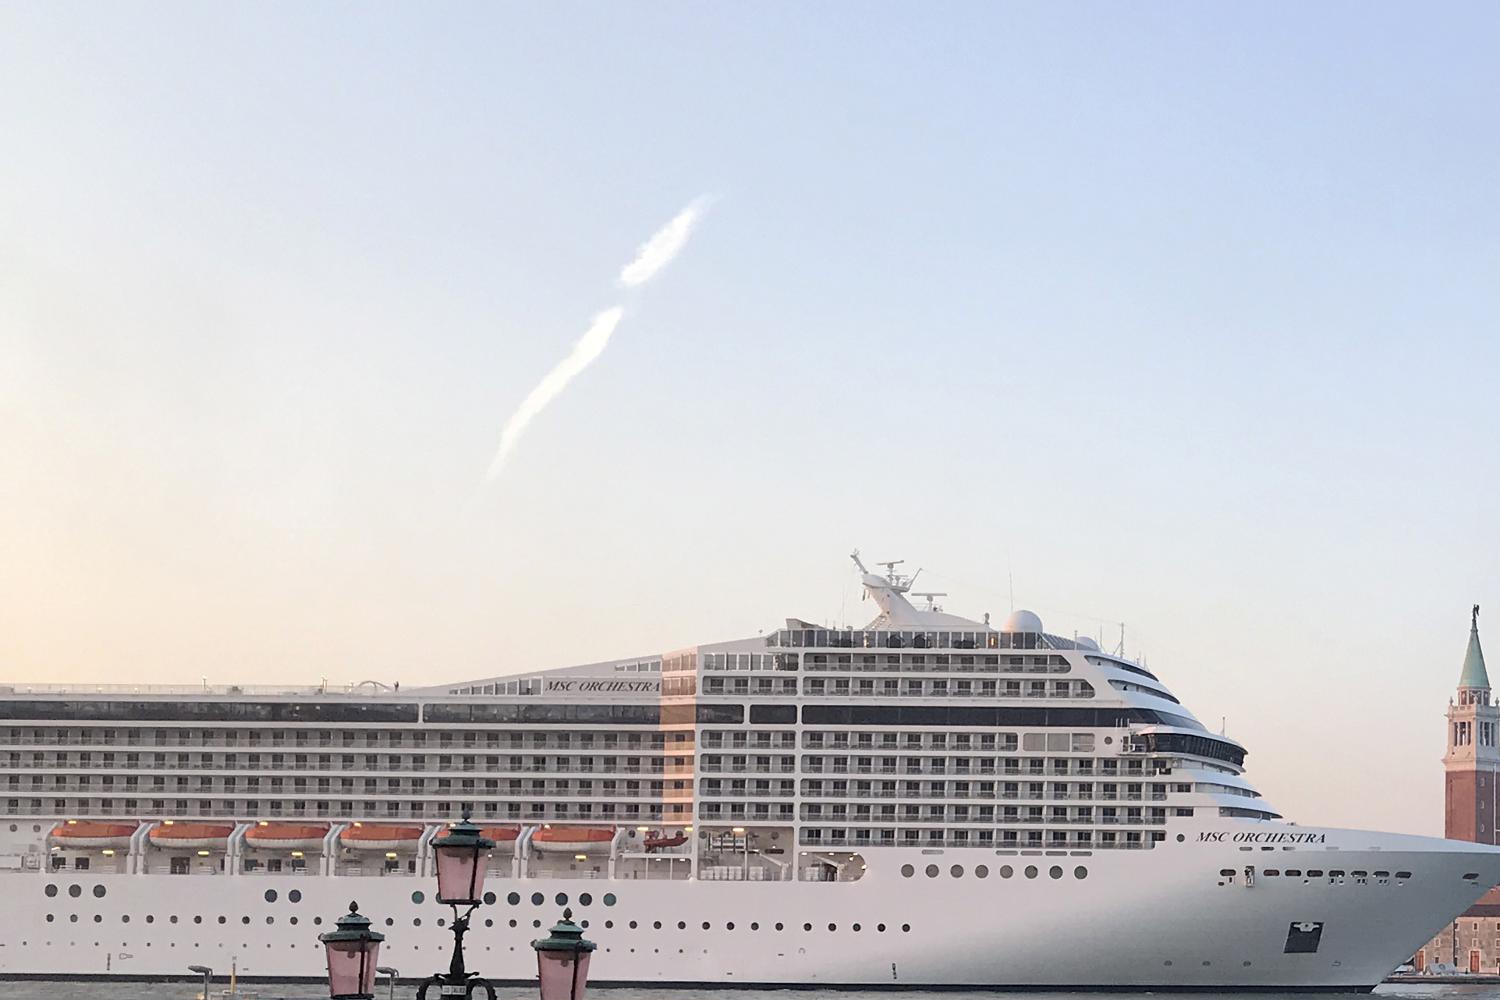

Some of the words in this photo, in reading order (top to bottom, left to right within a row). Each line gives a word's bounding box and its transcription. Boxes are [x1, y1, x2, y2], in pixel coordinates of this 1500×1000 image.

[545, 680, 577, 692] MSC
[578, 680, 660, 692] ORCHESTRA
[1195, 831, 1230, 842] MSC
[1232, 832, 1326, 844] ORCHESTRA
